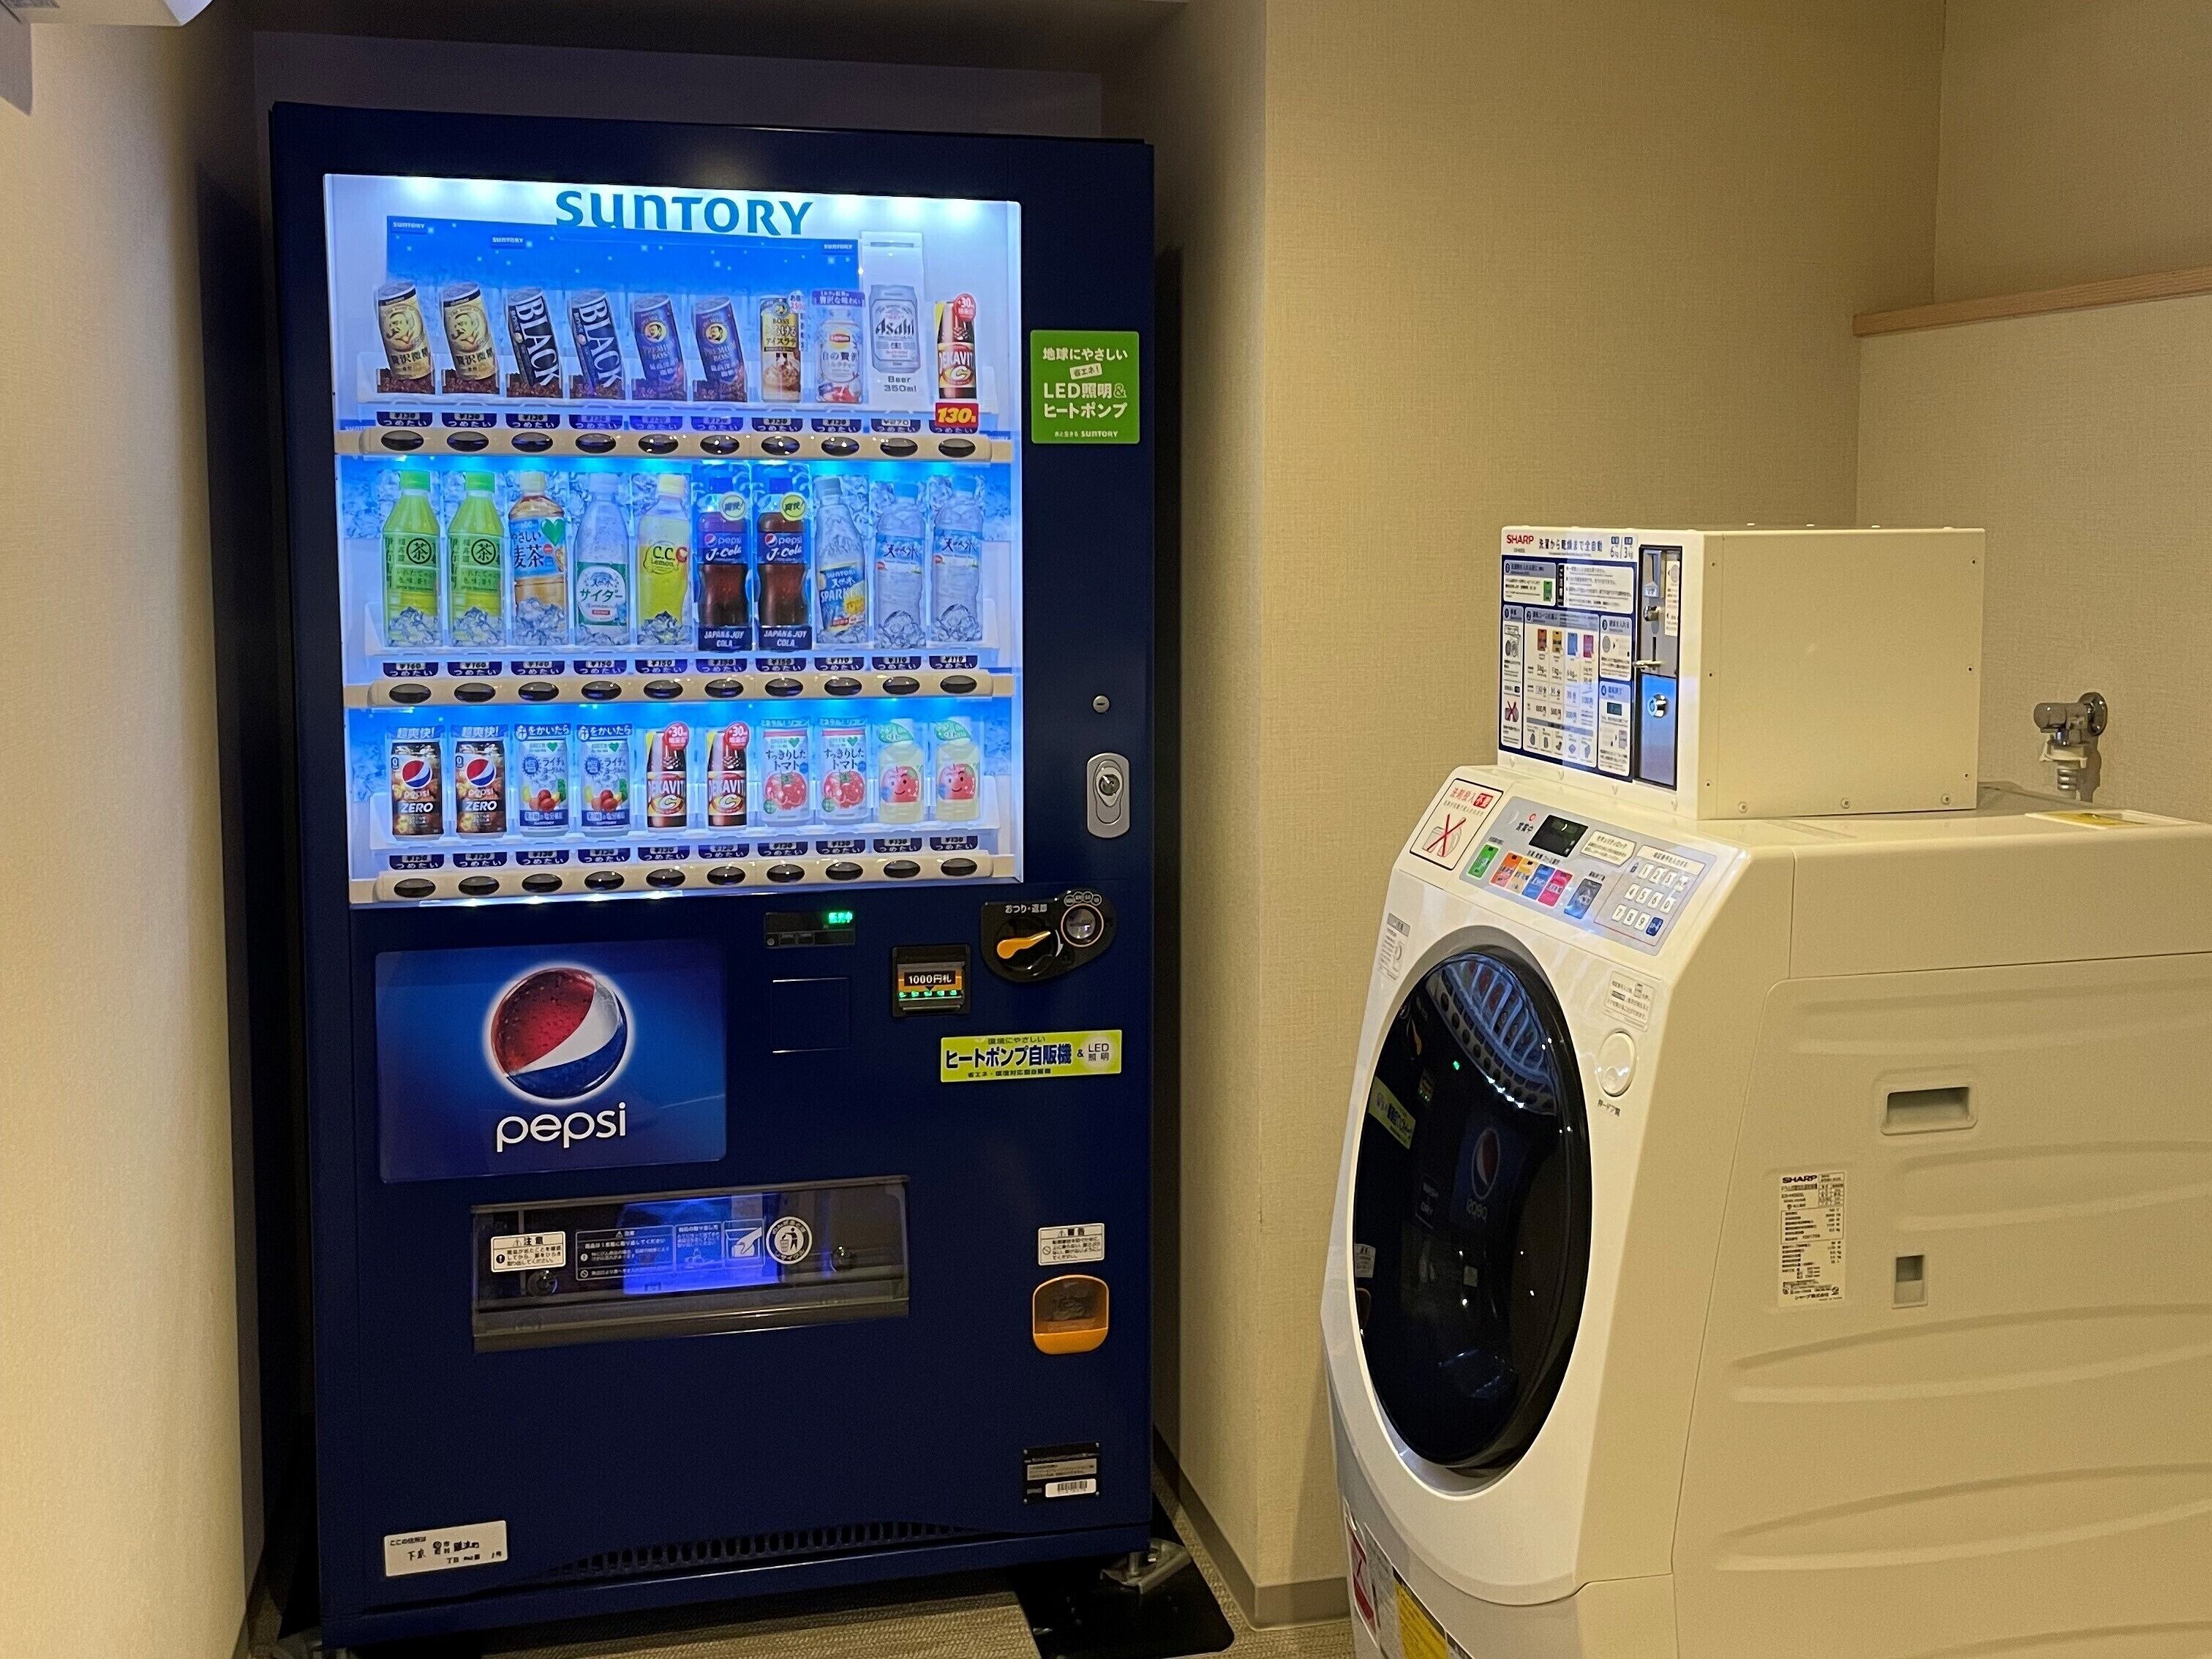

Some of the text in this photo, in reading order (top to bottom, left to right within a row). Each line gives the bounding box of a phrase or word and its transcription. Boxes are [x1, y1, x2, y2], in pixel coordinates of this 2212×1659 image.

[556, 190, 813, 236] SUNTORY
[875, 318, 914, 336] Asahi
[515, 298, 560, 385] BLACK
[579, 299, 623, 388] BLACK
[1042, 347, 1129, 361] 地球にやさしい
[1074, 366, 1100, 377] 省エネ!
[884, 384, 917, 392] 350ml
[1044, 402, 1128, 419] ヒートポンプ
[511, 530, 541, 543] やさしい
[1506, 535, 1534, 545] SHARP
[411, 542, 428, 561] 茶
[475, 543, 492, 562] 茶
[580, 588, 622, 603] サイダー
[716, 639, 733, 647] COLA
[777, 639, 795, 647] COLA
[397, 726, 434, 739] 超爽快!
[462, 726, 499, 739] 超爽快!
[766, 749, 806, 761] すっきりした
[824, 748, 865, 759] すっきりした
[774, 760, 800, 771] トマト
[832, 759, 857, 770] トマト
[401, 802, 433, 813] ZERO
[465, 801, 497, 811] ZERO
[908, 974, 952, 984] 1000円札
[1088, 1043, 1110, 1053] LED
[946, 1043, 1084, 1069] ヒートポンプ自販機 &
[1088, 1052, 1110, 1061] 照明
[496, 1102, 626, 1153] pepsi
[1782, 1175, 1817, 1184] SHARP
